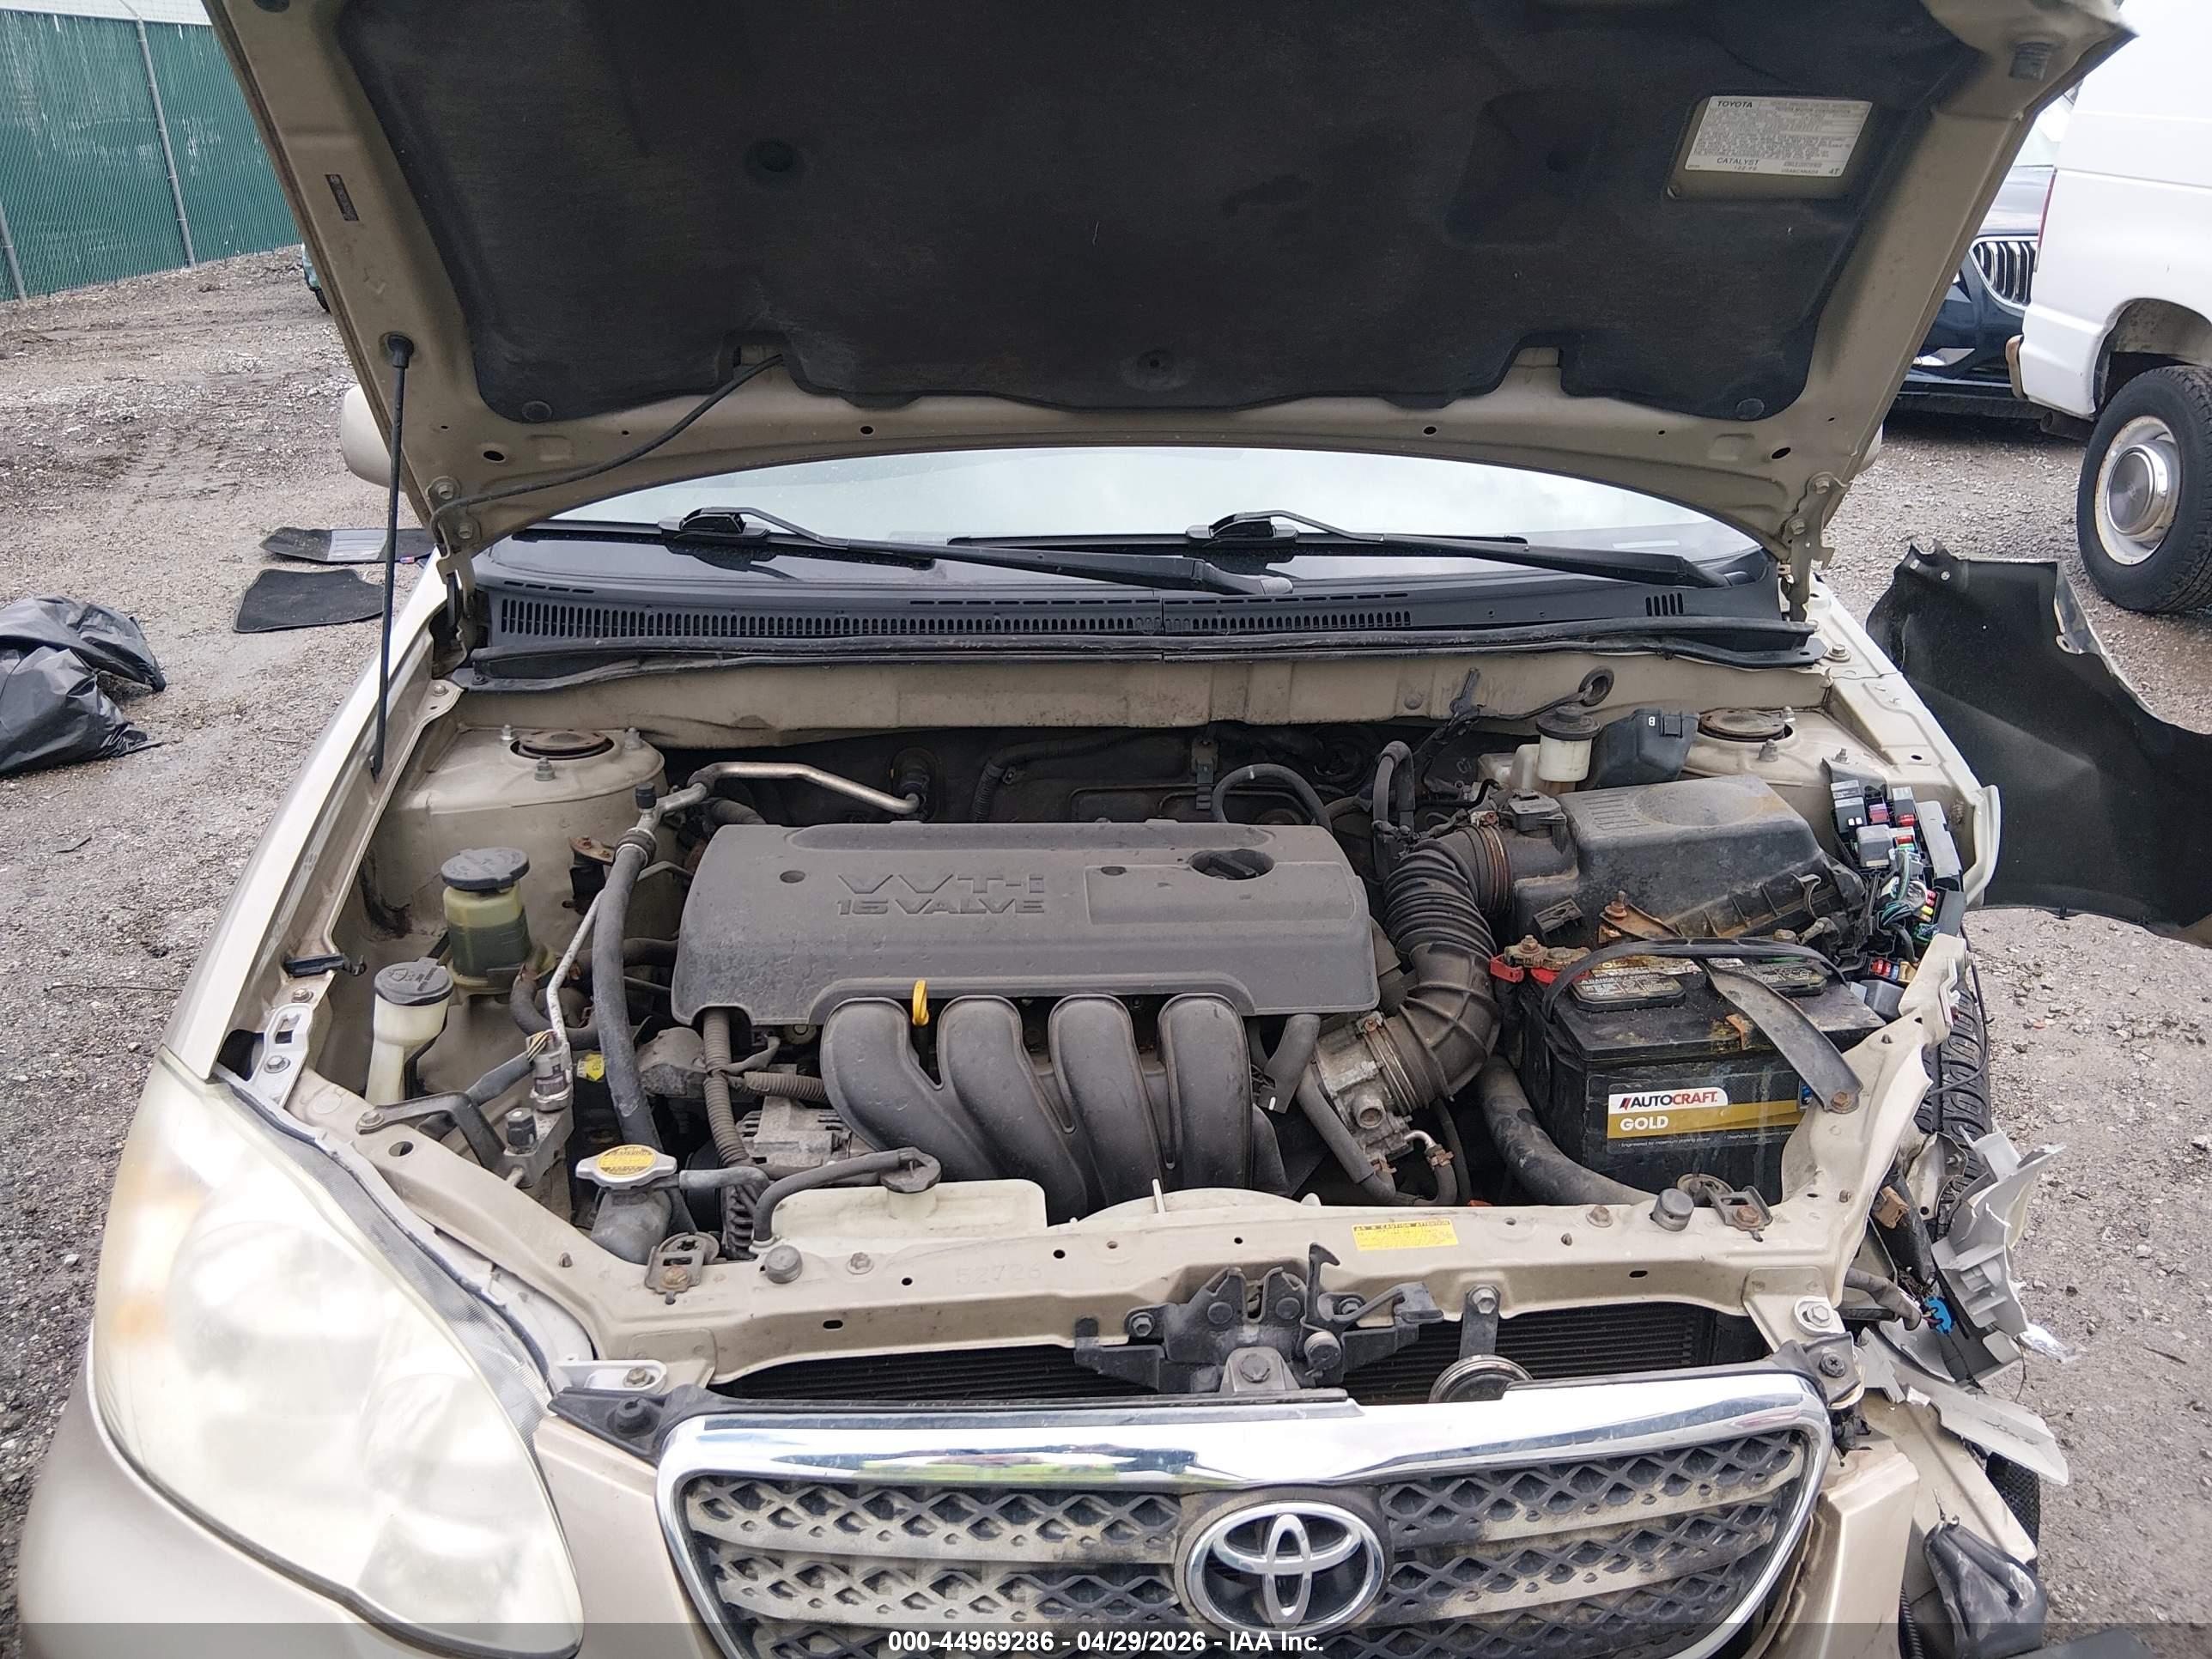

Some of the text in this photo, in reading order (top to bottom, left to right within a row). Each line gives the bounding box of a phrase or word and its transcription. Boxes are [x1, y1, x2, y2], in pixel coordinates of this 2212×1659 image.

[1717, 100, 1753, 108] TOYOTA
[1717, 156, 1759, 166] CATALYST
[1631, 1091, 1717, 1108] AUTOCRAFT
[1620, 1115, 1668, 1132] GOLD
